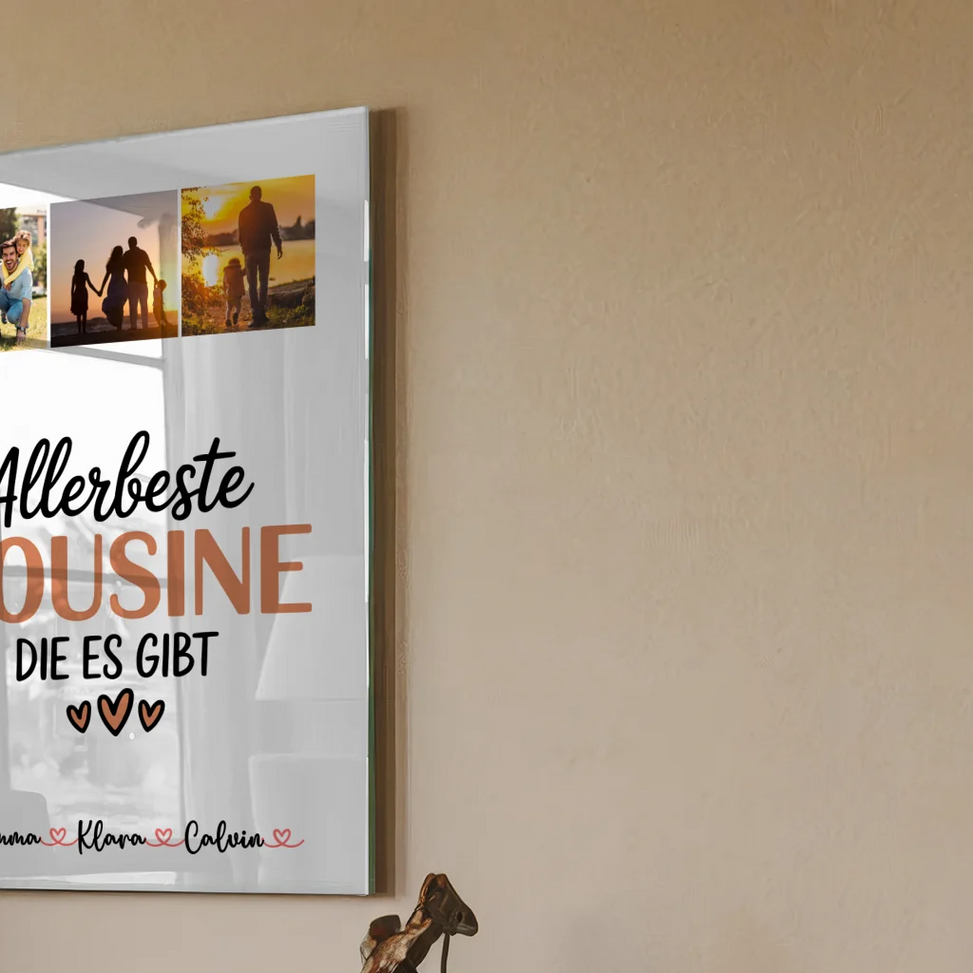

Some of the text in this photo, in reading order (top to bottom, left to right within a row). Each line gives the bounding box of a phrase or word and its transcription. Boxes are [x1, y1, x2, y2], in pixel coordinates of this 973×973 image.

[16, 631, 220, 682] DIE ES GIBT
[77, 819, 147, 855] Klara
[184, 819, 265, 855] Calvin
